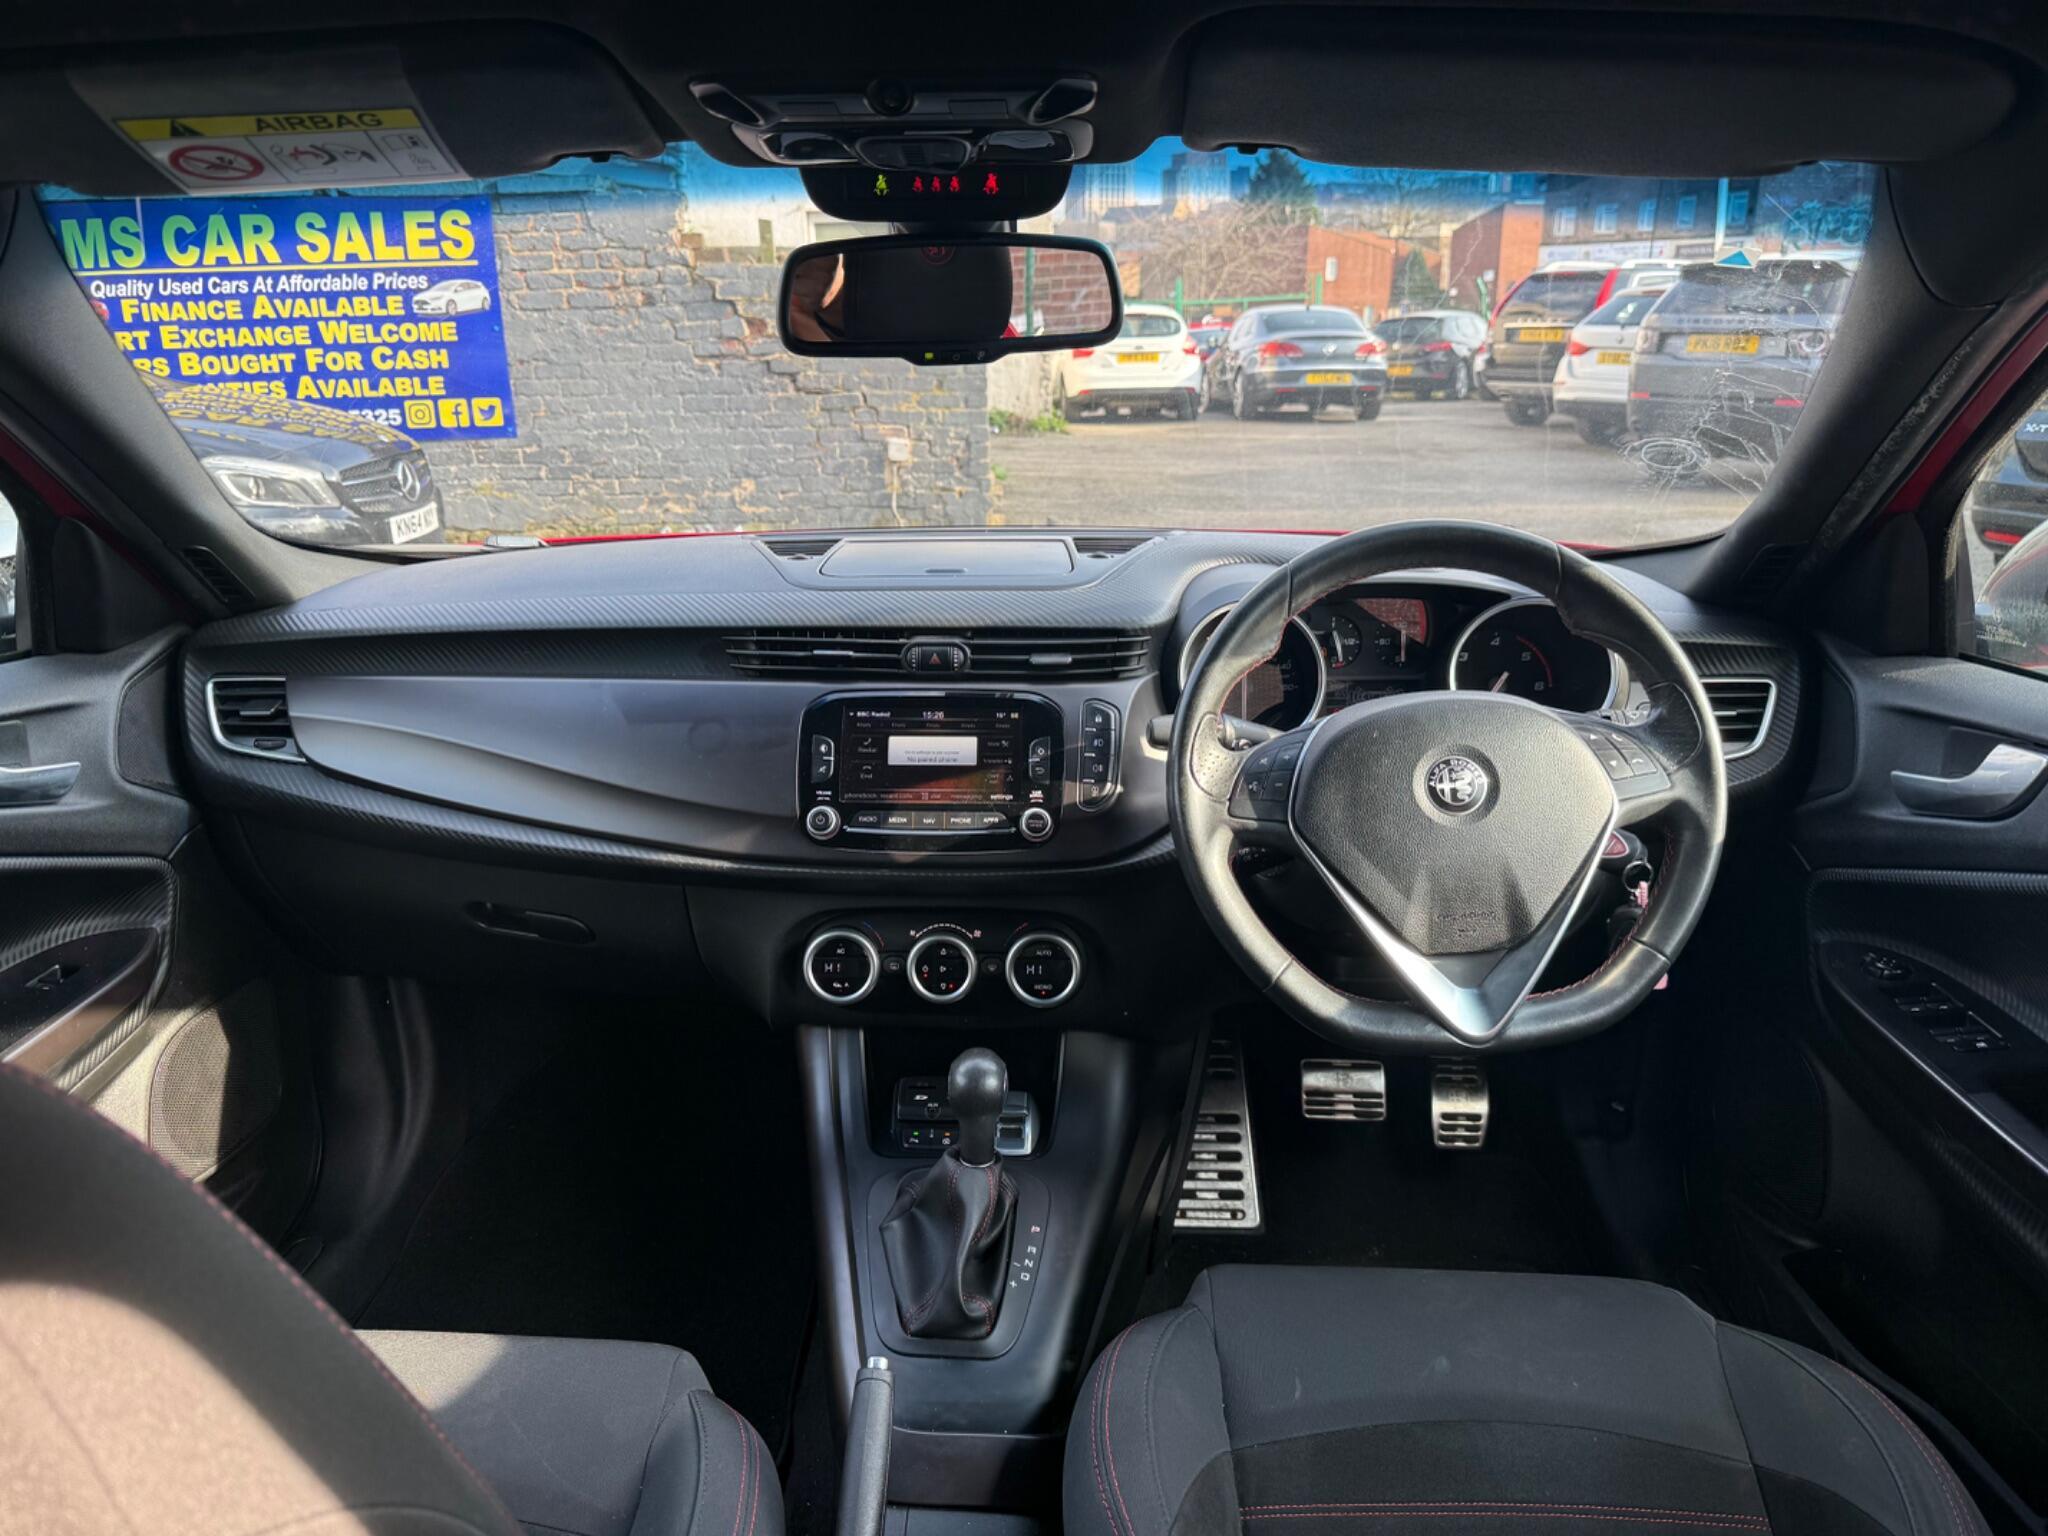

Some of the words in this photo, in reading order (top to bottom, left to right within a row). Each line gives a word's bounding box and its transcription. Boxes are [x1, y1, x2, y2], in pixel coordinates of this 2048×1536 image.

[256, 112, 384, 133] AIRBAG
[60, 215, 146, 269] MS
[162, 213, 282, 267] CAR
[295, 208, 475, 264] SALES
[90, 279, 154, 300] Quality
[158, 277, 203, 296] Used
[207, 276, 249, 295] Cars
[253, 275, 273, 294] At
[277, 273, 369, 293] Affordable
[372, 272, 429, 291] Prices
[120, 298, 244, 323] FINANCE
[253, 294, 406, 320] AVAILABLE
[159, 324, 312, 350] EXCHANGE
[317, 319, 458, 345] WELCOME
[178, 351, 296, 376] BOUGHT
[304, 347, 364, 373] FOR
[371, 345, 450, 371] CASH
[297, 375, 447, 399] AVAILABLE
[348, 408, 403, 427] 325
[1490, 636, 1501, 646] 4
[1458, 651, 1469, 662] 3
[1521, 651, 1532, 662] 5
[888, 816, 908, 824] MEDIA
[923, 817, 936, 825] NAV
[950, 816, 972, 824] PHONE
[1035, 949, 1053, 957] AUTO
